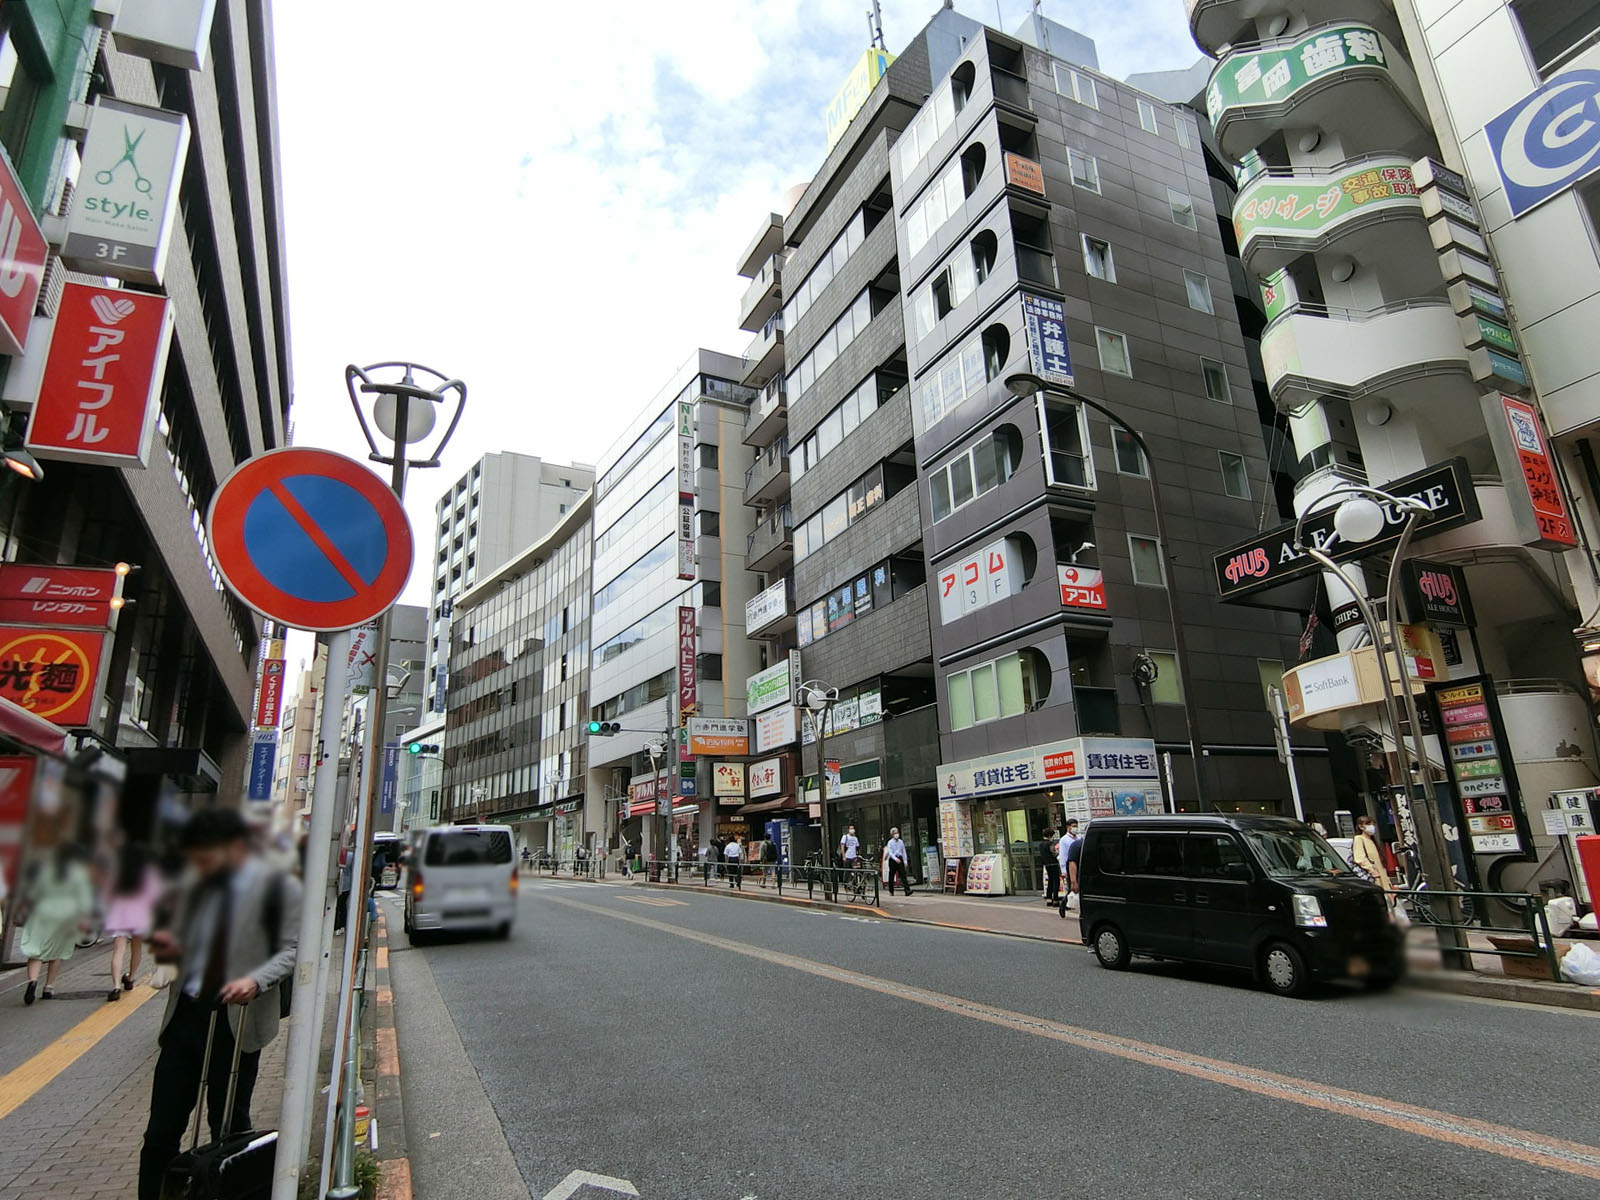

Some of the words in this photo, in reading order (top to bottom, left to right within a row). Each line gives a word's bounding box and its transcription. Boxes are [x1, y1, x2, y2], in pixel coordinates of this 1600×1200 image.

[1341, 170, 1381, 194] 交通
[1351, 183, 1389, 205] 事故
[1242, 187, 1342, 221] マッサージ
[95, 242, 127, 260] 3F
[1042, 320, 1068, 374] 弁護士
[66, 326, 125, 443] アイフル
[1539, 517, 1557, 535] 2F
[941, 551, 1005, 598] アコム
[1224, 547, 1270, 585] HUB
[1065, 588, 1103, 605] アコム
[1418, 570, 1457, 606] HUB
[32, 600, 97, 614] レンタカー
[681, 610, 696, 700] ツルハドラッグ
[1313, 675, 1350, 693] SoftBank
[1086, 753, 1149, 770] 賃貸住宅
[849, 779, 877, 793] 三井住友銀行
[973, 763, 1030, 788] 賃貸住宅
